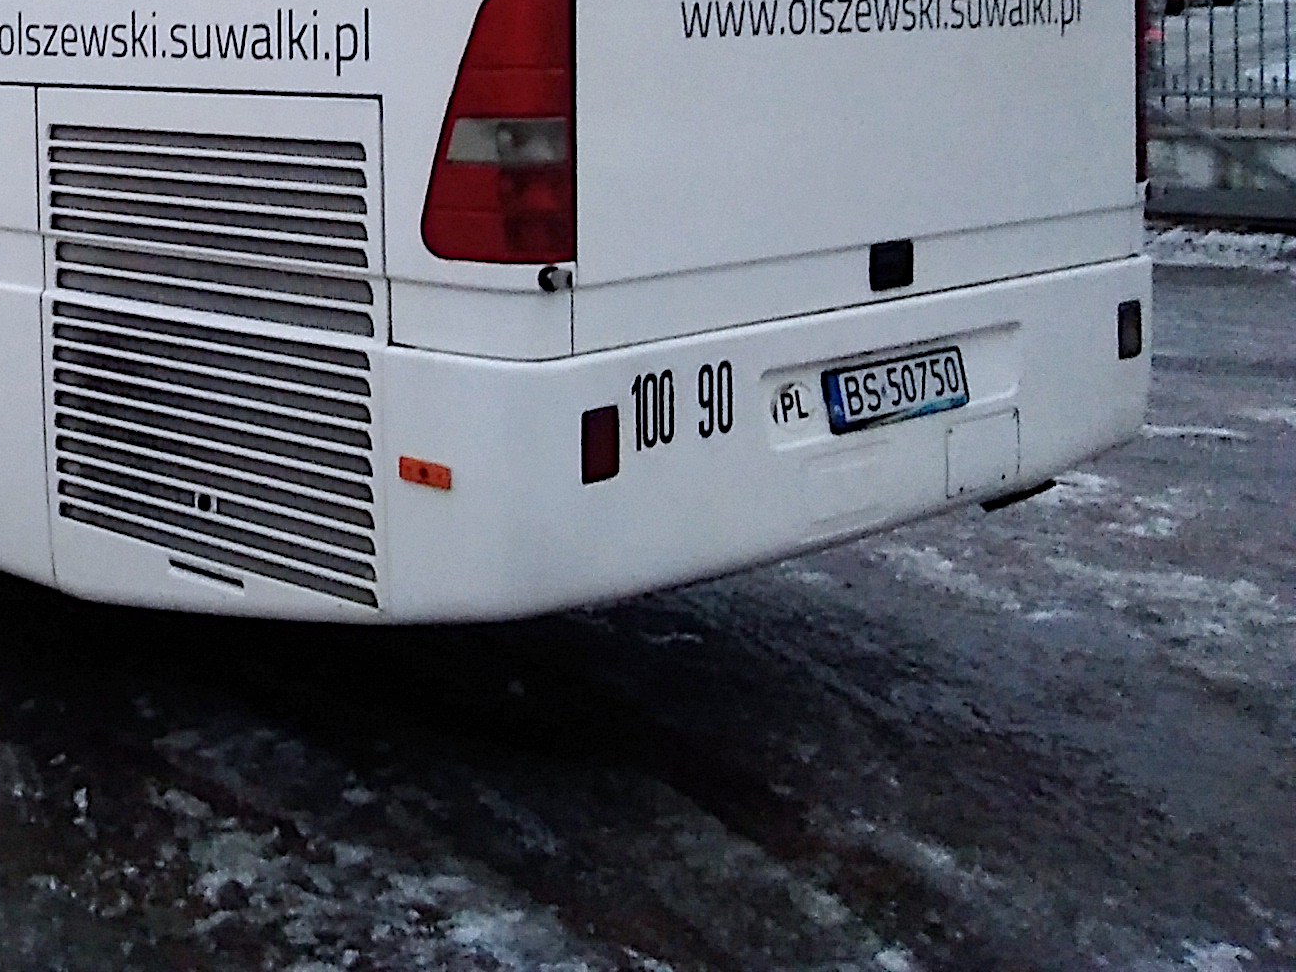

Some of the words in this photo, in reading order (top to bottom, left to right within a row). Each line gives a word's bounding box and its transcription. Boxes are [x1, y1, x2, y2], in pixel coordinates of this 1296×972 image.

[631, 369, 675, 452] 100
[698, 360, 733, 439] 90
[780, 389, 810, 423] PL
